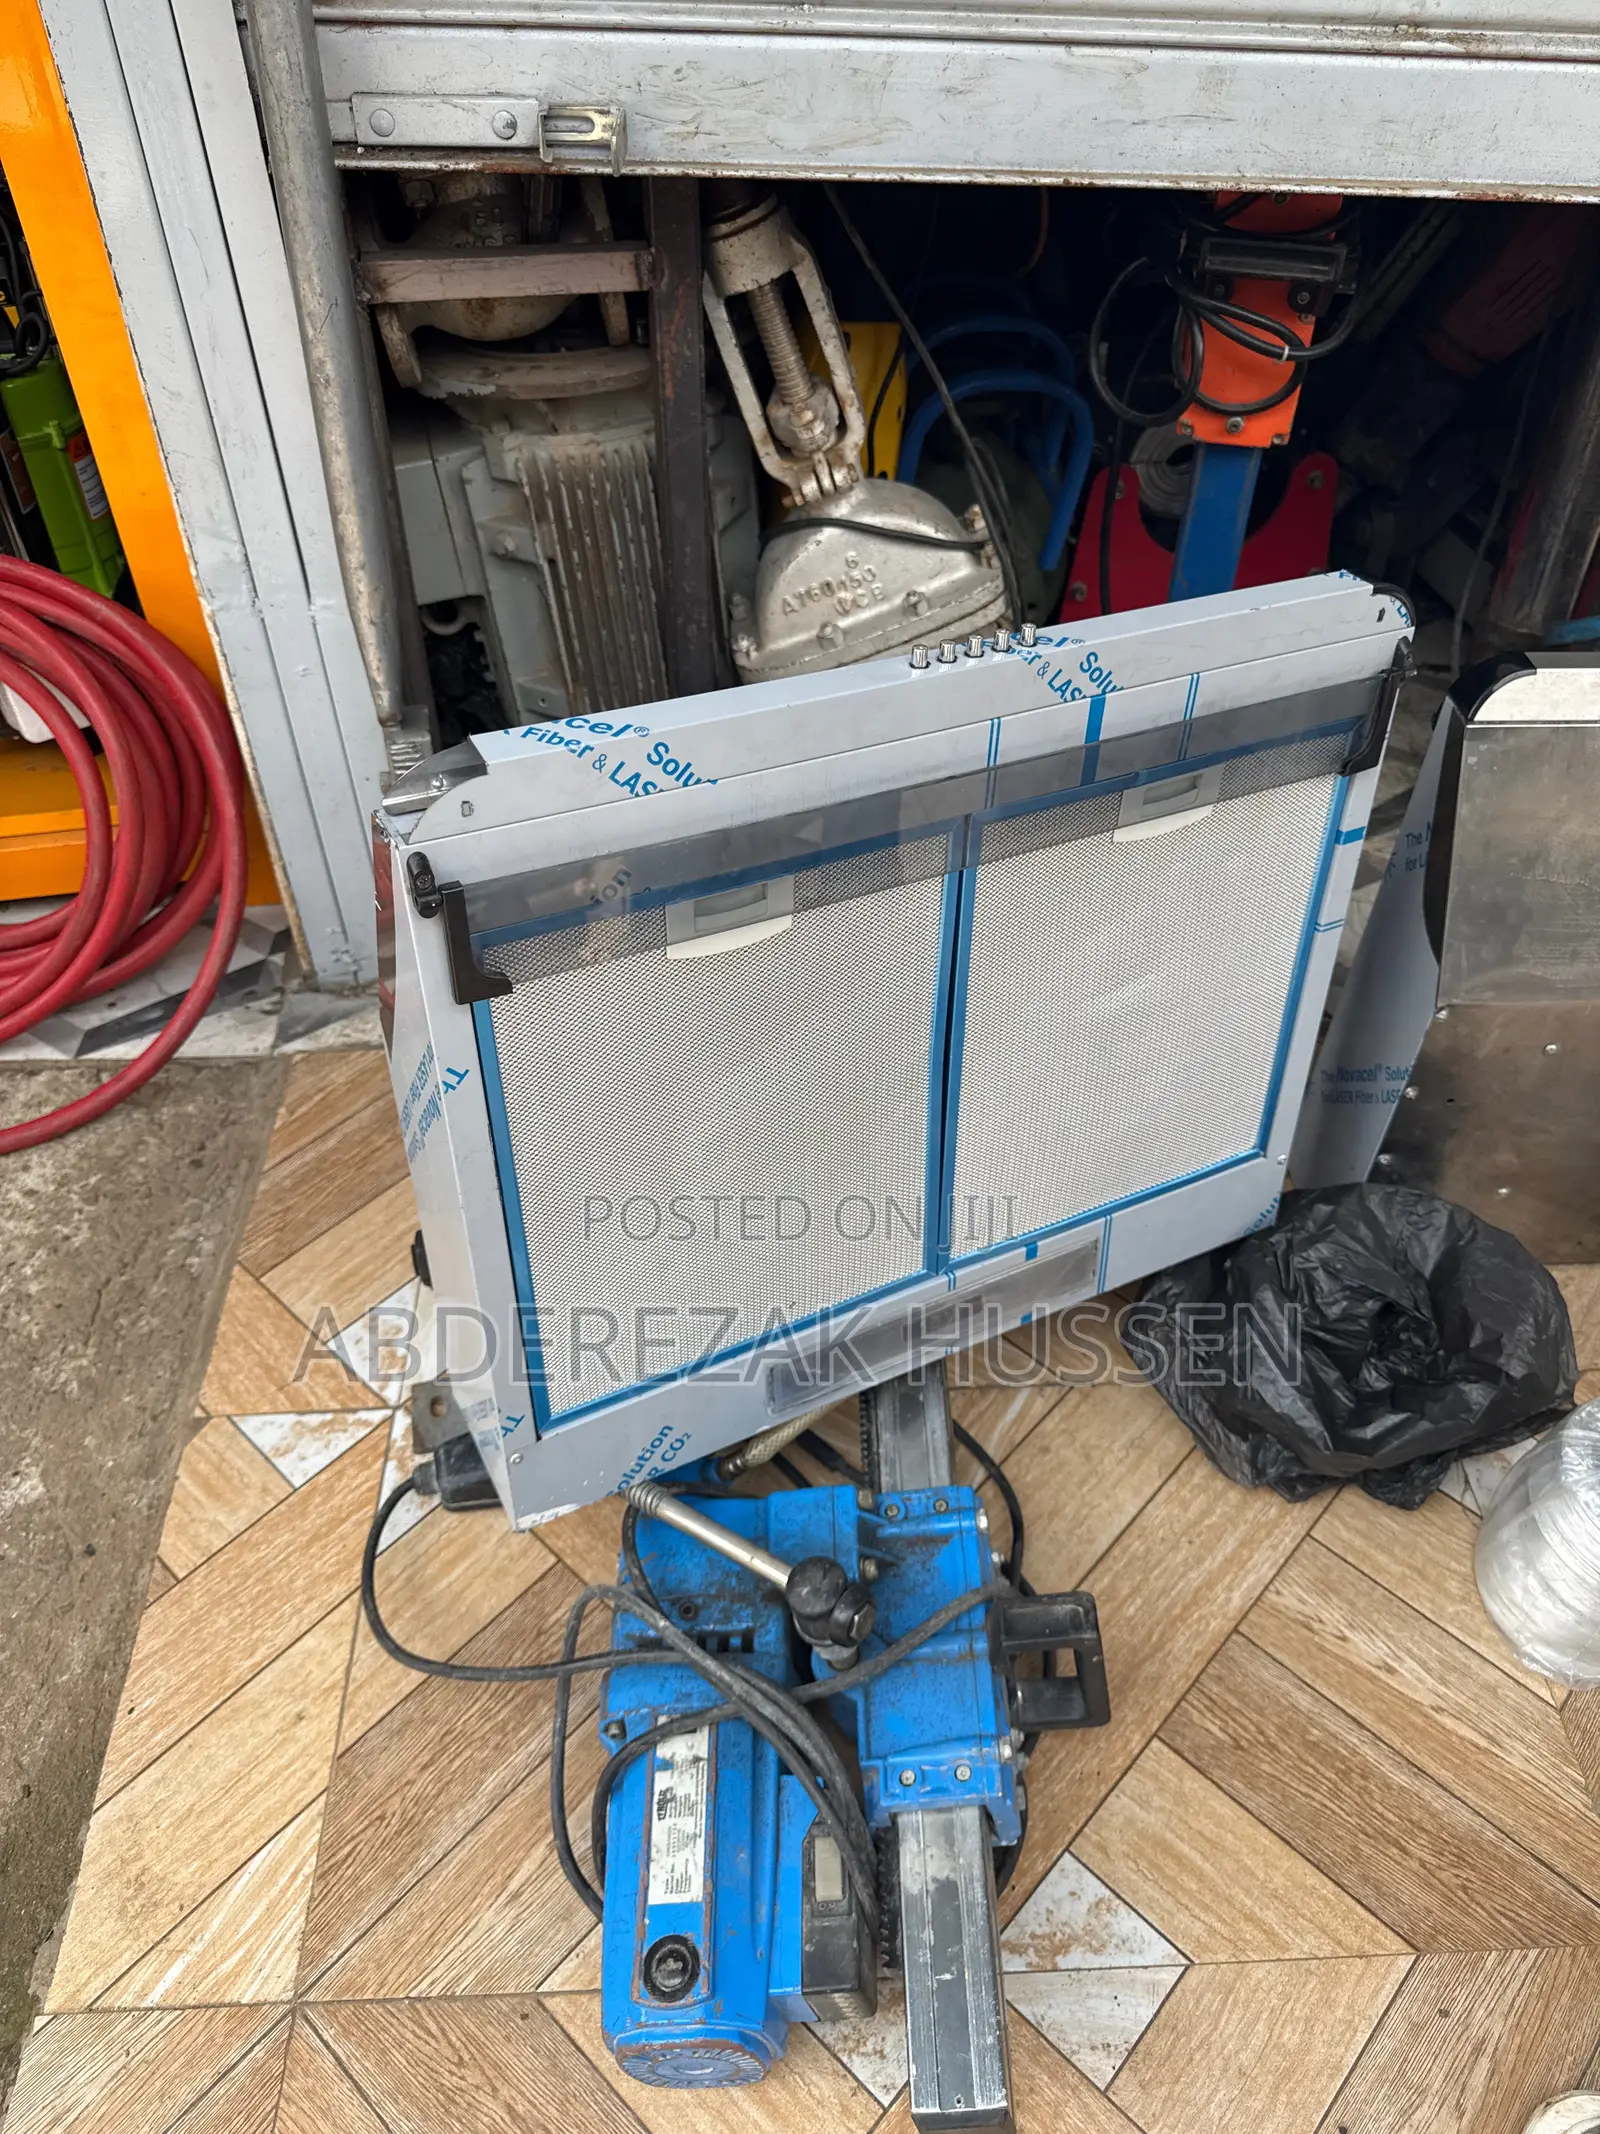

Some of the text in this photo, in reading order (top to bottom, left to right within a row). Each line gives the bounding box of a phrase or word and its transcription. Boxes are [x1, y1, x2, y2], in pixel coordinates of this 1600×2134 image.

[551, 716, 650, 738] cel®
[520, 726, 595, 759] Fiber
[592, 753, 608, 774] &
[1404, 831, 1423, 849] The
